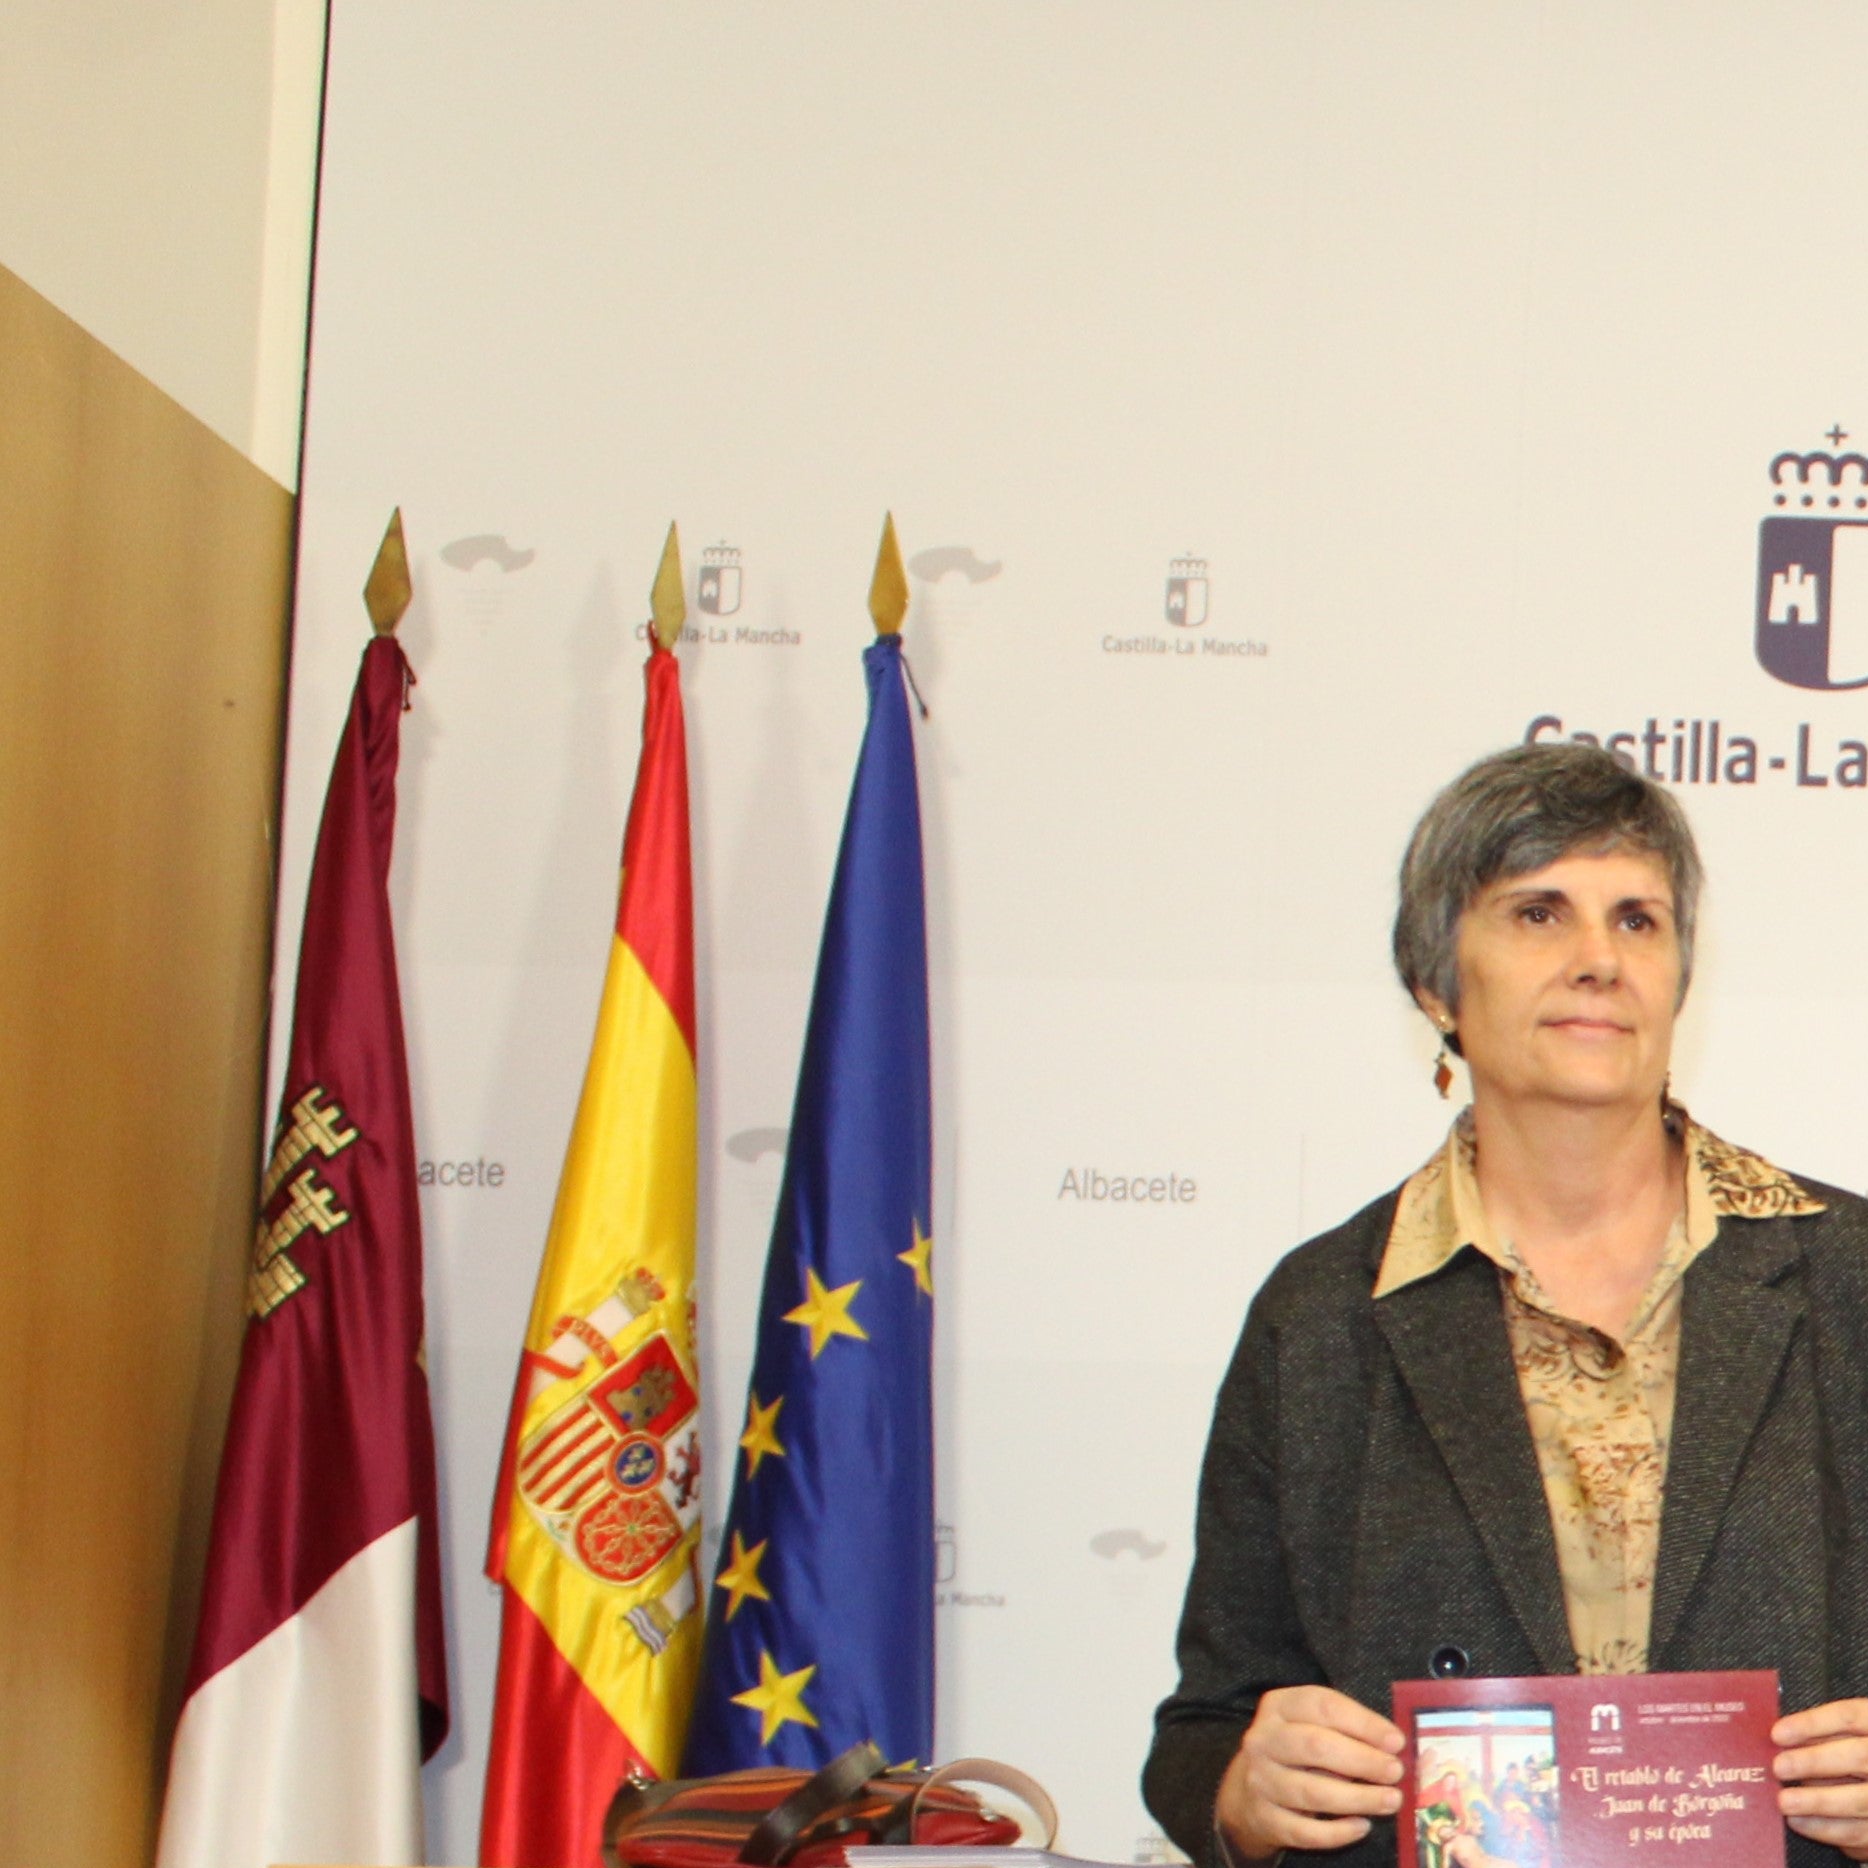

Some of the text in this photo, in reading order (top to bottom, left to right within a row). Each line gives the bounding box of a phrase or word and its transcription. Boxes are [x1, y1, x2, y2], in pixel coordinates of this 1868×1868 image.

[735, 624, 801, 645] Mancha
[1202, 637, 1268, 657] Mancha
[1058, 1167, 1197, 1202] Albacete
[1570, 1766, 1598, 1792] El
[1605, 1765, 1660, 1785] retablo
[1665, 1766, 1684, 1784] de
[1594, 1793, 1745, 1818] Juan de Borgoña
[1628, 1827, 1640, 1847] y
[1644, 1825, 1664, 1841] su
